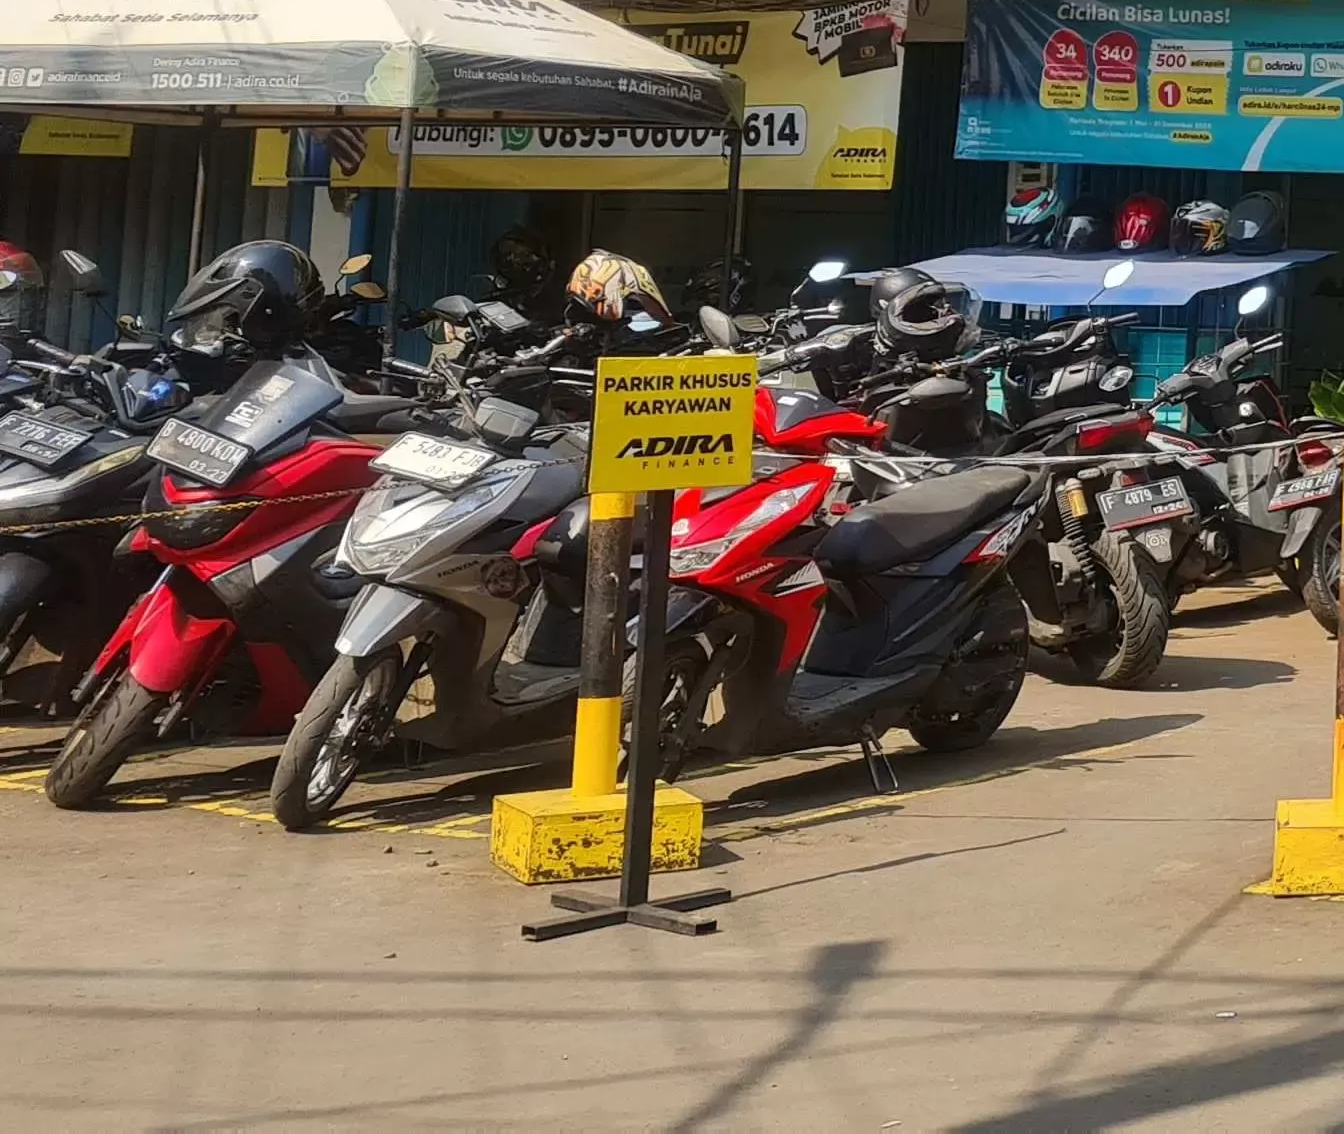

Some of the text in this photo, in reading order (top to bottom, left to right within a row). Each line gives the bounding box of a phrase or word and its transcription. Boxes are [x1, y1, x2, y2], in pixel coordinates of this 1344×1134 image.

[1057, 2, 1231, 24] Cicilan Bisa Lunas!
[814, 13, 847, 33] BPKB
[824, 20, 863, 40] MOBIL
[1055, 44, 1077, 59] 34
[1099, 45, 1134, 62] 340
[1156, 53, 1187, 68] 500
[183, 57, 206, 67] Adira
[208, 57, 241, 67] Finance
[1265, 62, 1303, 72] adiraku
[151, 72, 300, 89] 1500 511 adira.co.id
[454, 67, 484, 80] Untuk
[486, 69, 519, 83] segala
[520, 71, 572, 85] kebutuhan
[618, 77, 703, 103] #AdirainAja
[1186, 85, 1213, 95] Kupon
[1163, 84, 1174, 105] 1
[394, 127, 495, 151] ubungi:
[832, 147, 887, 158] ADIRA
[604, 373, 751, 392] PARKIR KHUSUS
[624, 397, 731, 416] KARYAWAN
[614, 434, 734, 458] ADIRA
[642, 456, 735, 470] FINANCE
[1105, 495, 1115, 509] F
[1161, 483, 1178, 498] ES
[436, 559, 480, 579] HONDA
[735, 561, 775, 584] HONDA
